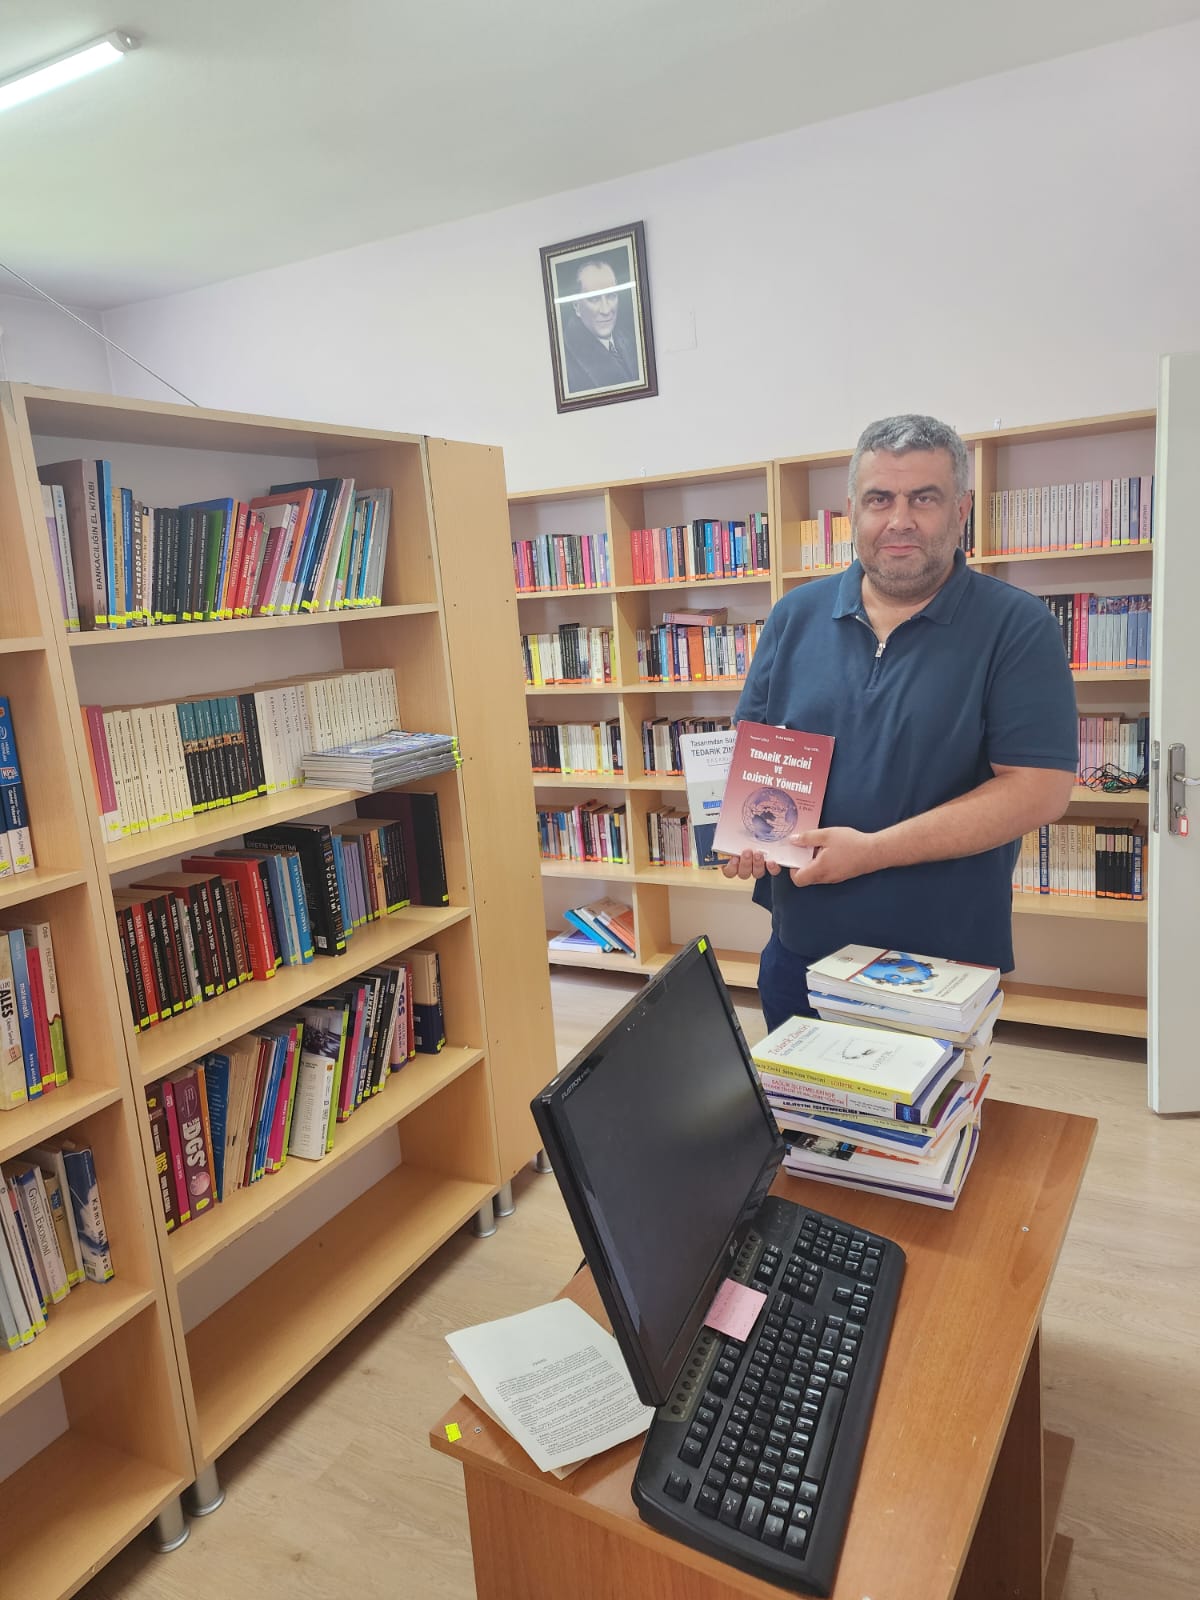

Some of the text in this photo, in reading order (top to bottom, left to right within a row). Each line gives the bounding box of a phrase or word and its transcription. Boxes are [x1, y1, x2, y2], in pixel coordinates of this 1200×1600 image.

[88, 481, 96, 510] KİTABI
[91, 513, 98, 524] EL
[691, 738, 723, 746] Tasarımdan
[691, 747, 720, 757] TEDARİK
[750, 748, 812, 770] TEDARİK ZİNCİRİ
[774, 766, 783, 774] VE
[742, 771, 812, 794] LOJİSTİK YÖNETİMİ
[0, 988, 14, 1019] ALES
[19, 983, 30, 1019] matematik
[182, 1120, 207, 1168] DGS
[155, 1152, 168, 1174] DGS
[28, 1187, 40, 1218] GENEL
[92, 1196, 100, 1228] Kamu
